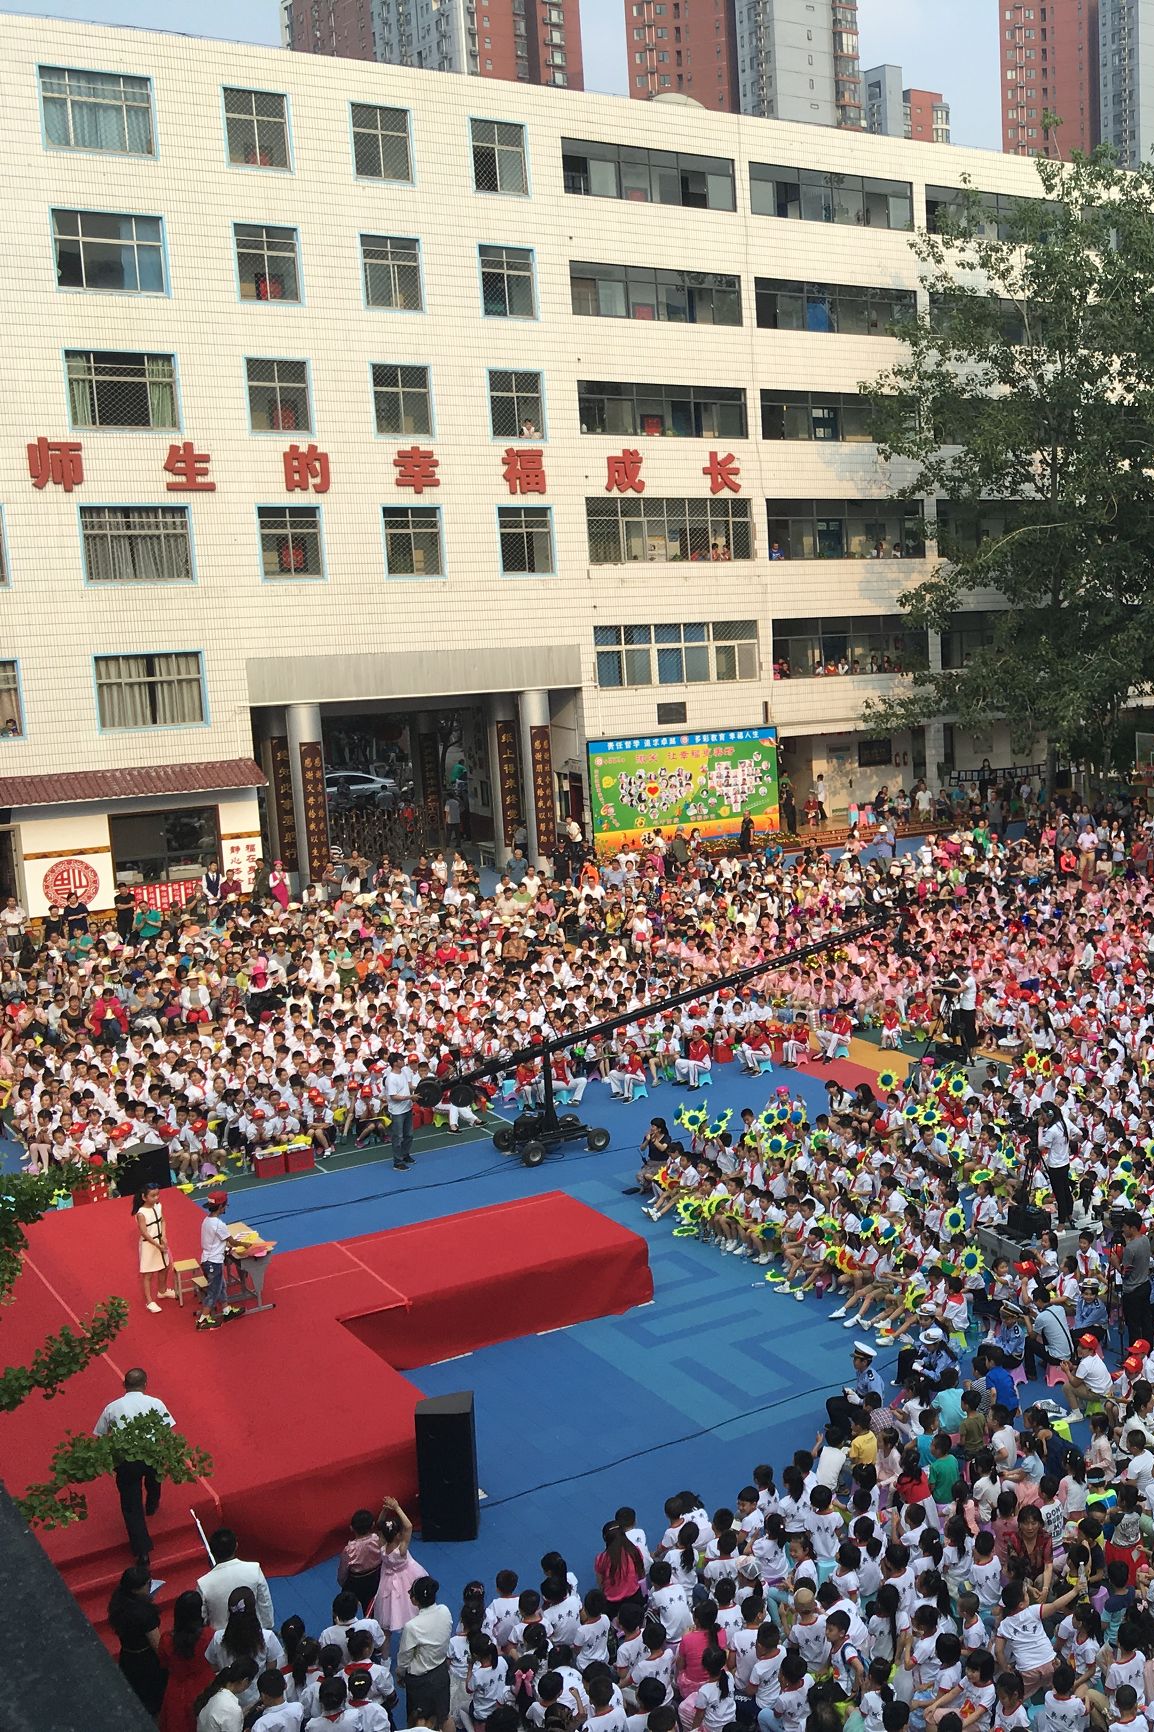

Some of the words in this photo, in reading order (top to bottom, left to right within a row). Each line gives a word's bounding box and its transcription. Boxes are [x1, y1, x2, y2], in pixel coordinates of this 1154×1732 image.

[27, 436, 743, 495] 师生的幸福成长
[729, 731, 760, 740] 幸福人生
